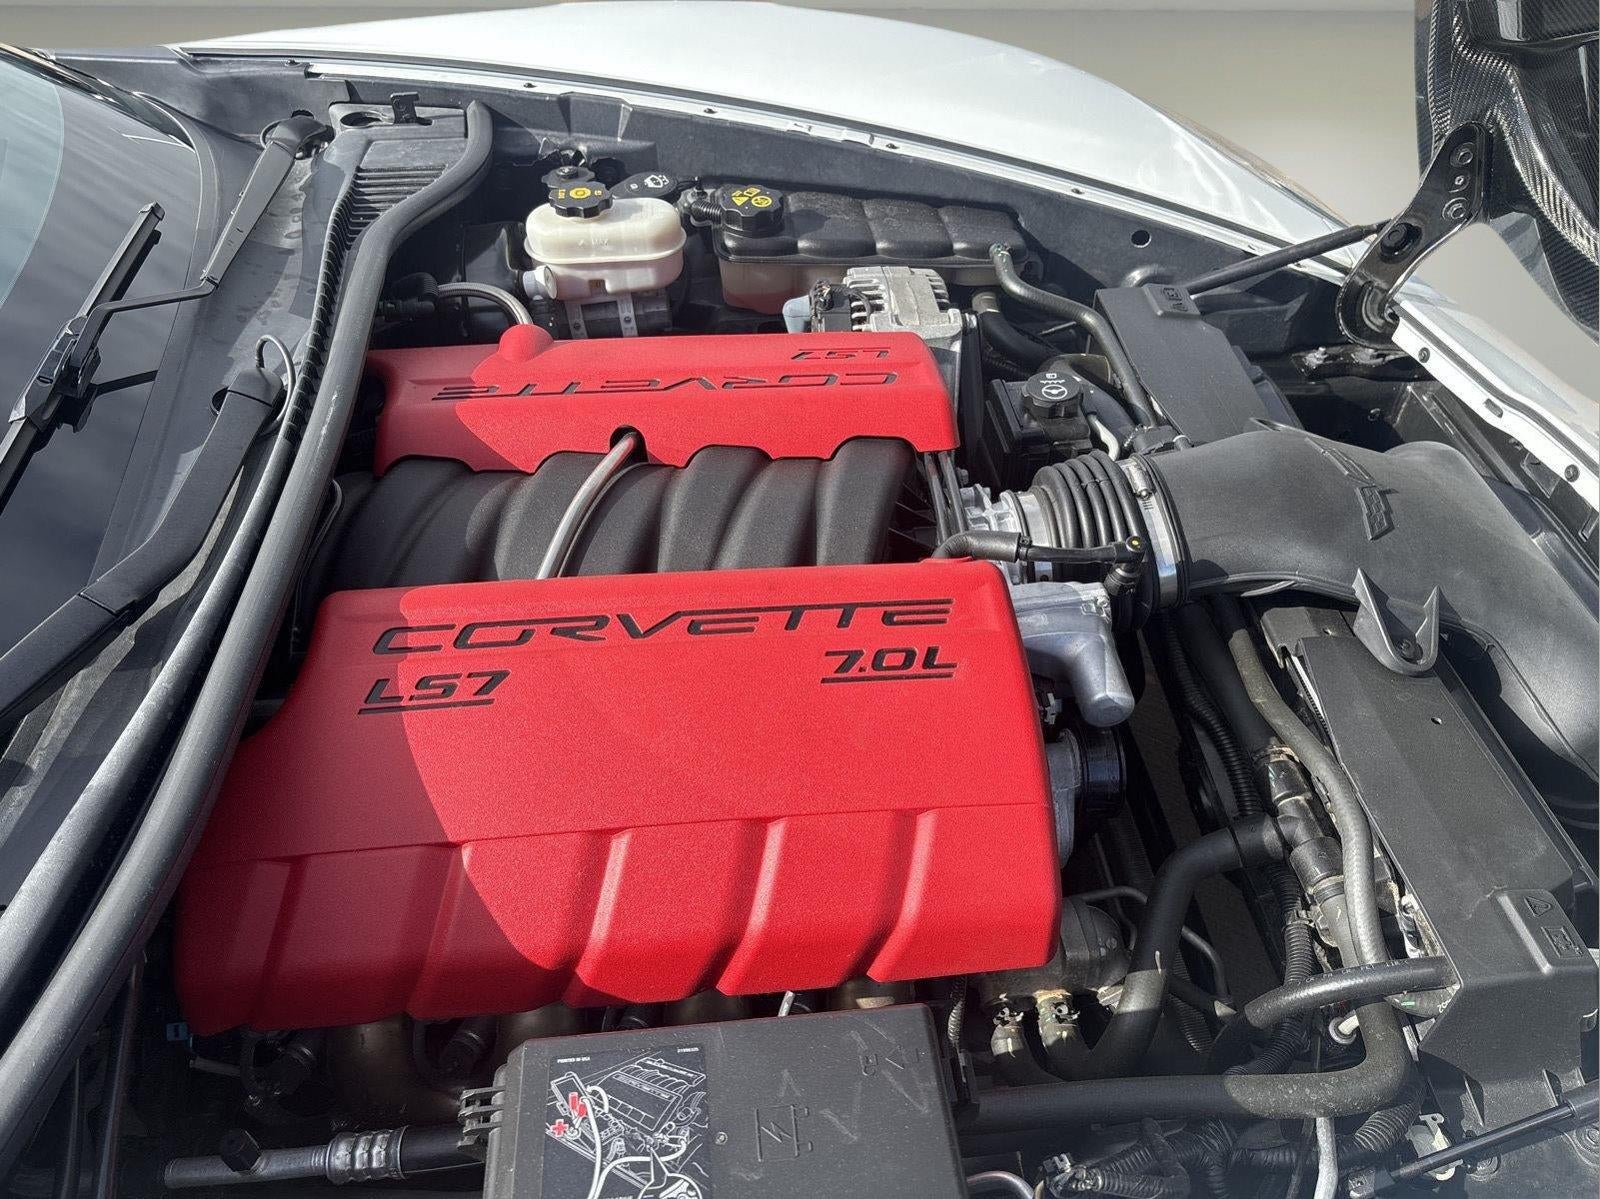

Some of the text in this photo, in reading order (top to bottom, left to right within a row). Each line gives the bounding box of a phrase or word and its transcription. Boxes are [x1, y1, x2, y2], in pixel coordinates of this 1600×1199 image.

[432, 372, 898, 401] CORVETTE
[373, 598, 954, 655] CORVETTE
[823, 646, 957, 677] 7.0L
[362, 669, 511, 707] LS7
